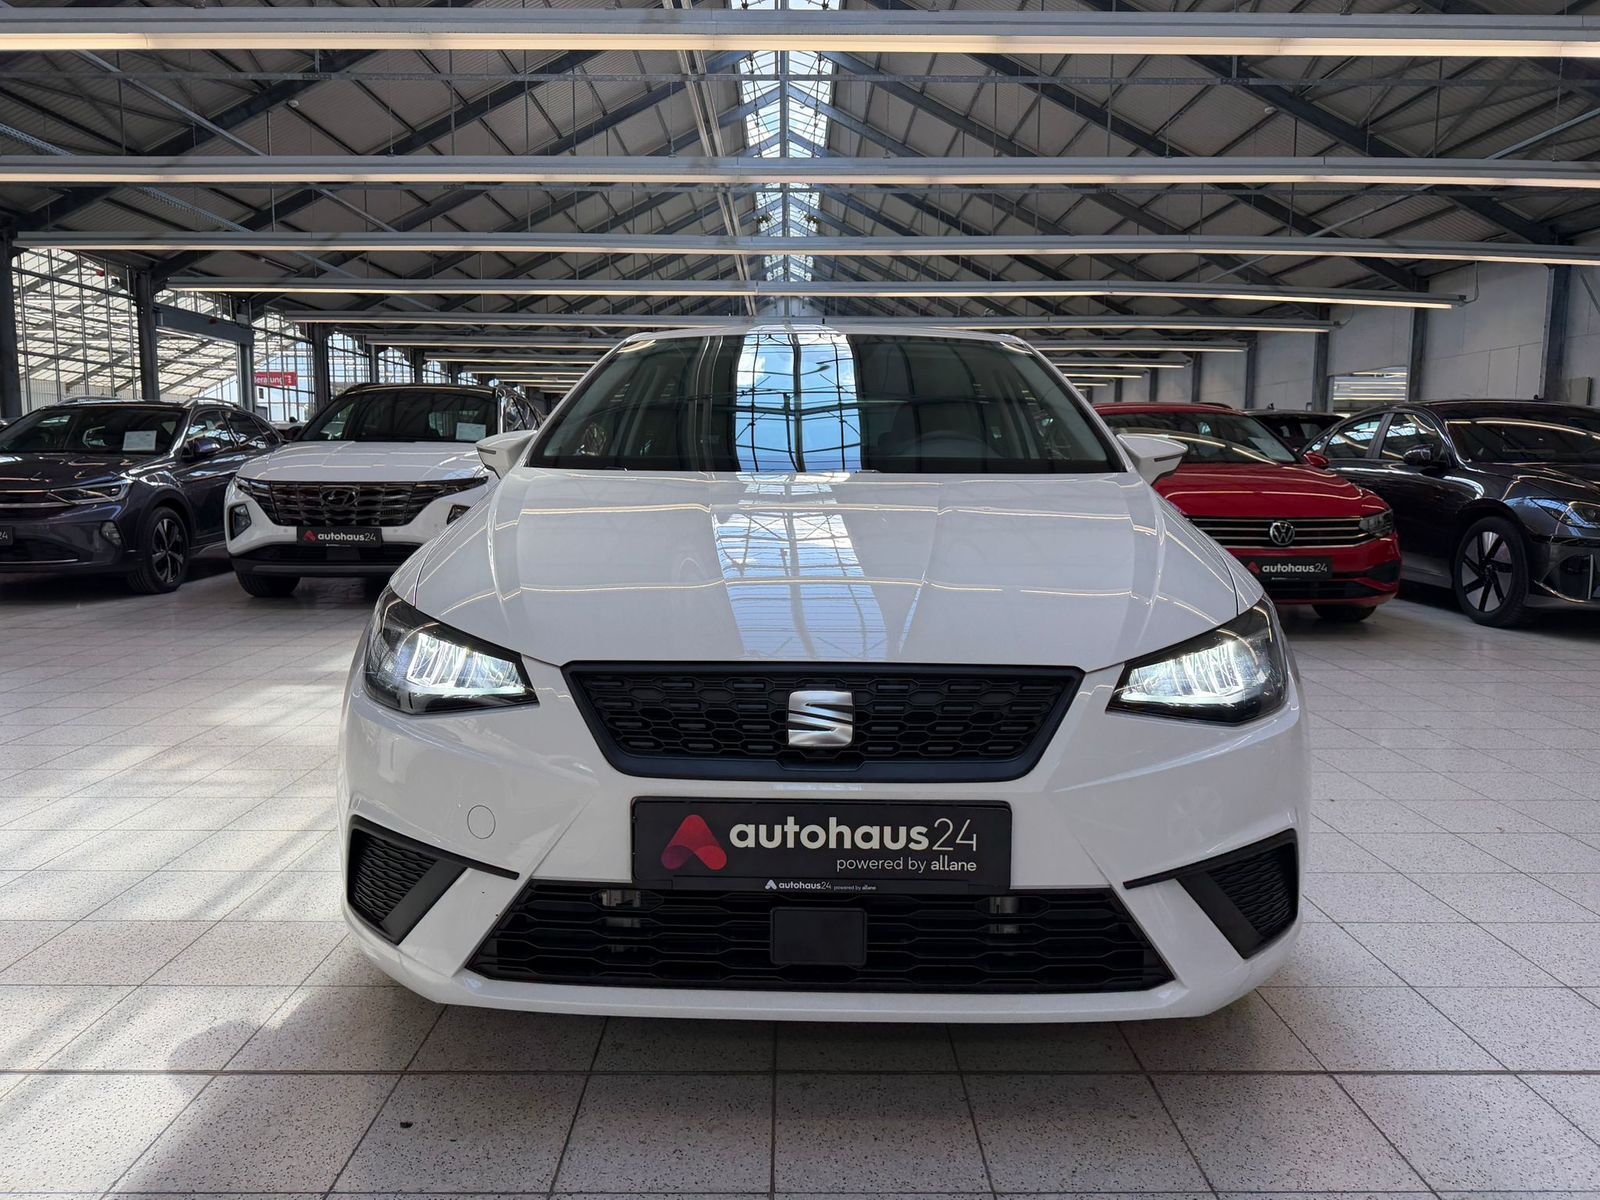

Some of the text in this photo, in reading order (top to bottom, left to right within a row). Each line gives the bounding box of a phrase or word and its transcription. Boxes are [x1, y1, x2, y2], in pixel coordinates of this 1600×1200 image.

[254, 376, 285, 386] eraung
[318, 532, 376, 541] autohaus24
[1262, 563, 1328, 573] autohaus24
[729, 816, 977, 851] autohaus24
[836, 855, 977, 873] powered by allane
[779, 881, 832, 890] autohaus24
